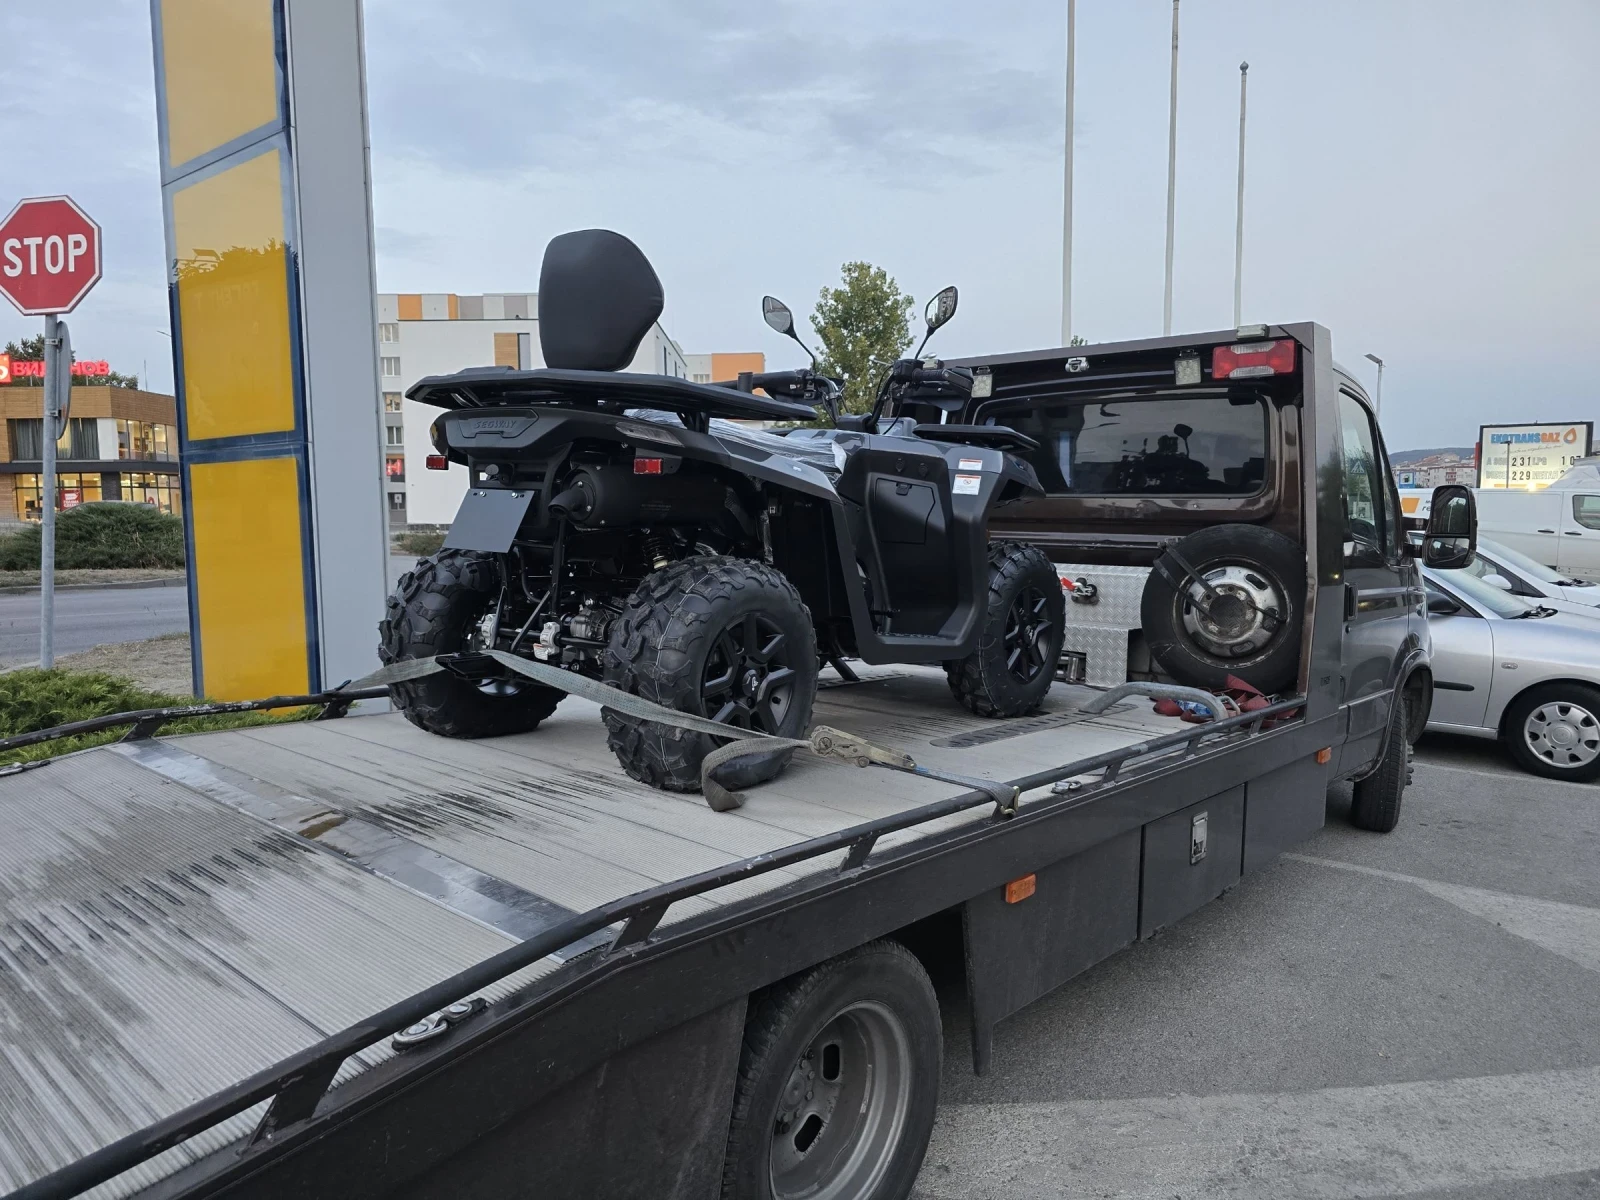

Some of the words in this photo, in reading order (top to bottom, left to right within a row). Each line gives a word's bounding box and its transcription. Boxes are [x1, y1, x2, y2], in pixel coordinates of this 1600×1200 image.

[3, 233, 88, 278] STOP
[474, 420, 517, 429] SEGWAY
[1511, 456, 1531, 467] 231
[1511, 470, 1531, 480] 229
